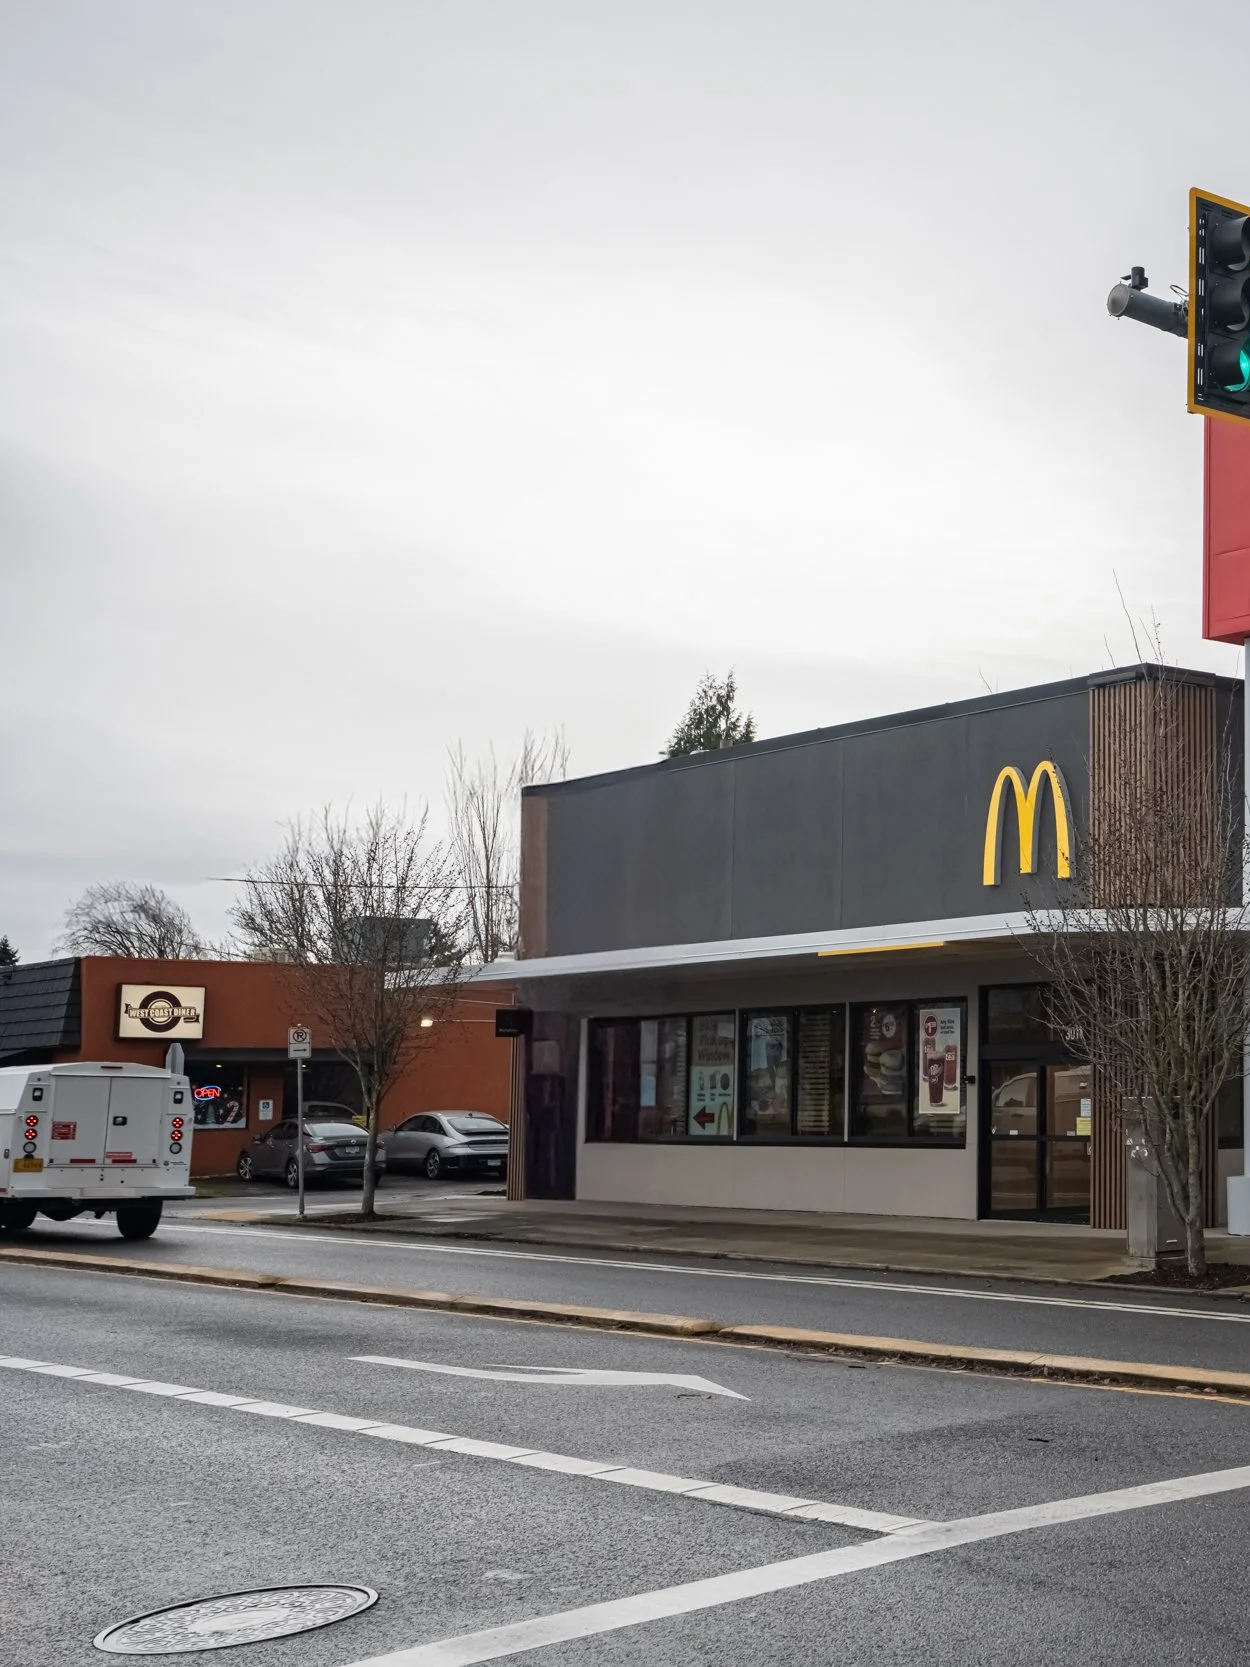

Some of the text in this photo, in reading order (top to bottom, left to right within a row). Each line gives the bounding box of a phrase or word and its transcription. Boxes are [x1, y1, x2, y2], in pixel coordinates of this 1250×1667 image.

[129, 1008, 196, 1017] WEST COAST DINER
[194, 1088, 220, 1098] OPEN
